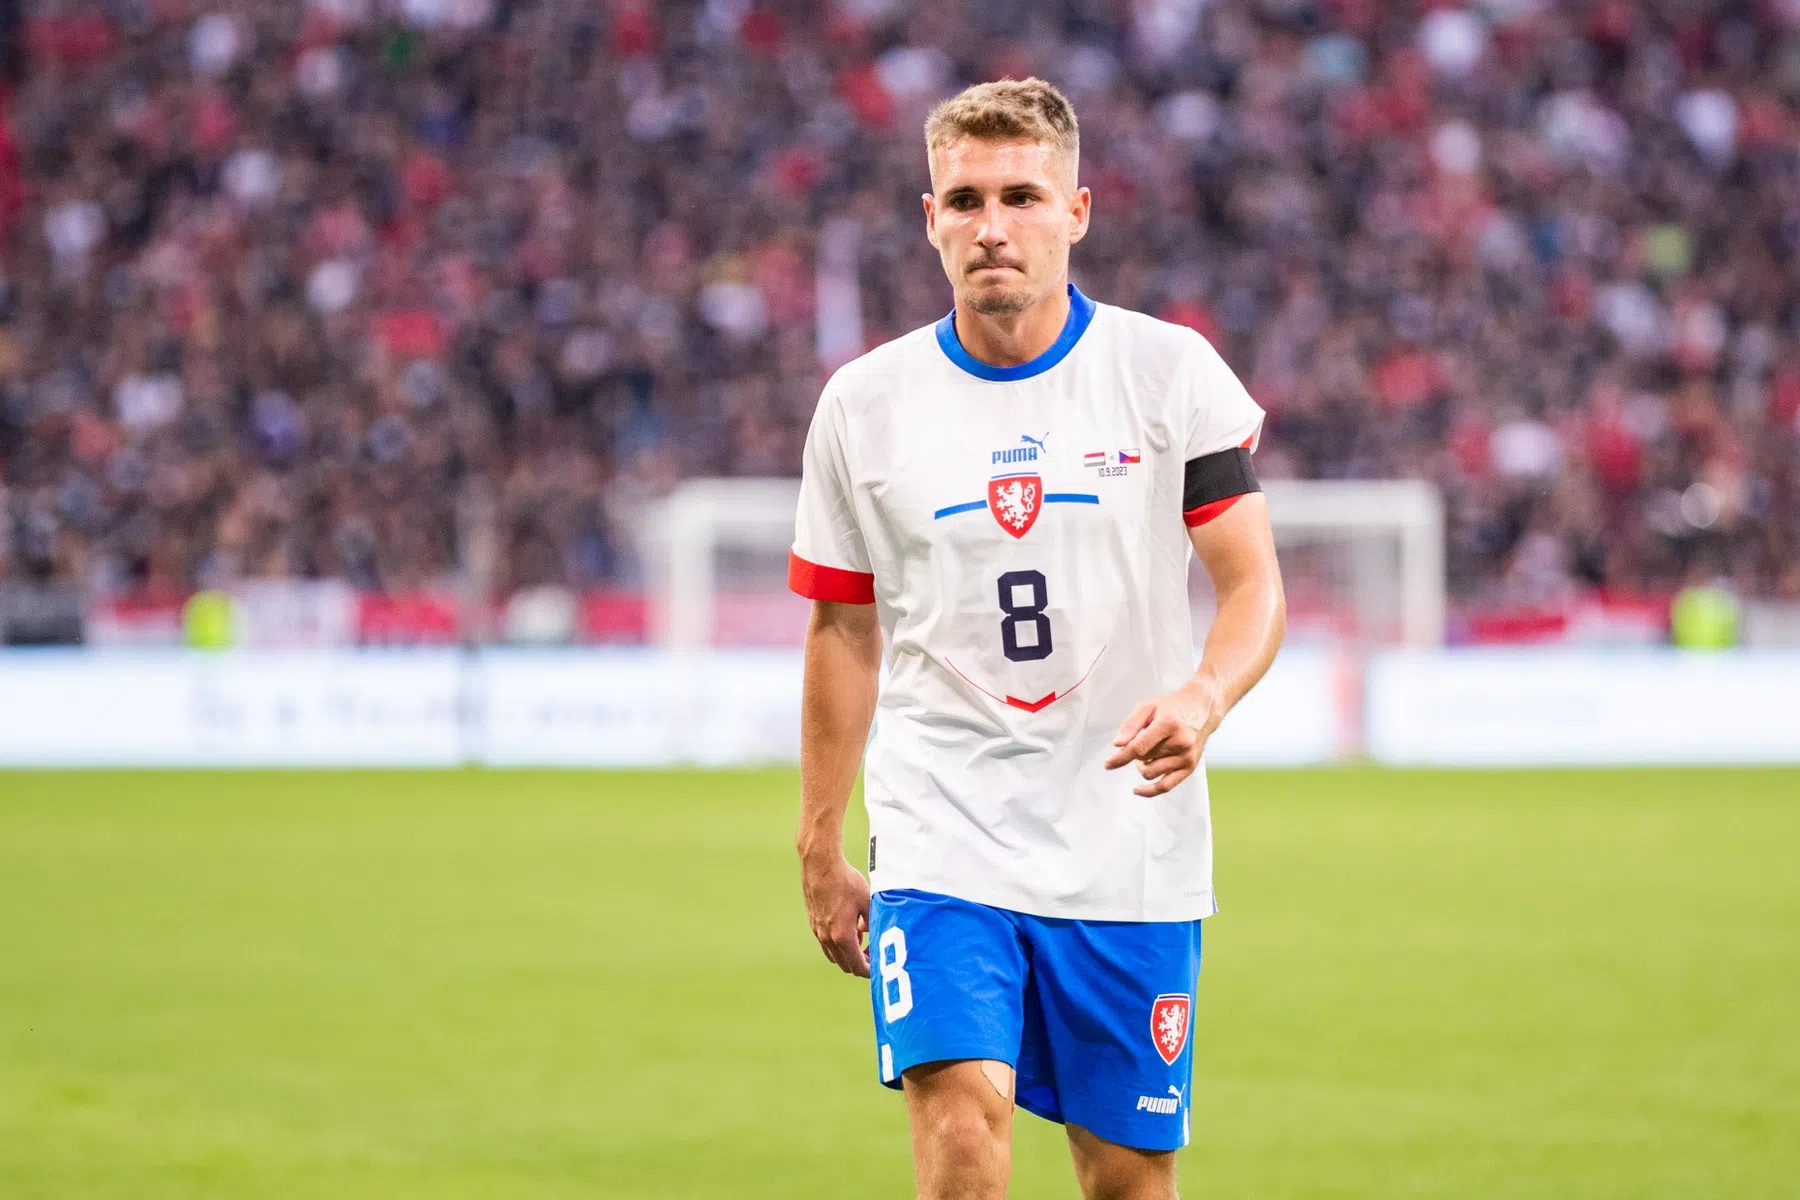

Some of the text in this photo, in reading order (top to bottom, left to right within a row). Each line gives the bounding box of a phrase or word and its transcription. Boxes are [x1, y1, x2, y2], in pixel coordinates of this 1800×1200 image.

[992, 447, 1038, 464] PUMA
[1098, 466, 1128, 477] 10.9.2023
[997, 569, 1053, 662] 8
[879, 925, 913, 1024] 8
[1136, 1095, 1178, 1115] PUMA
